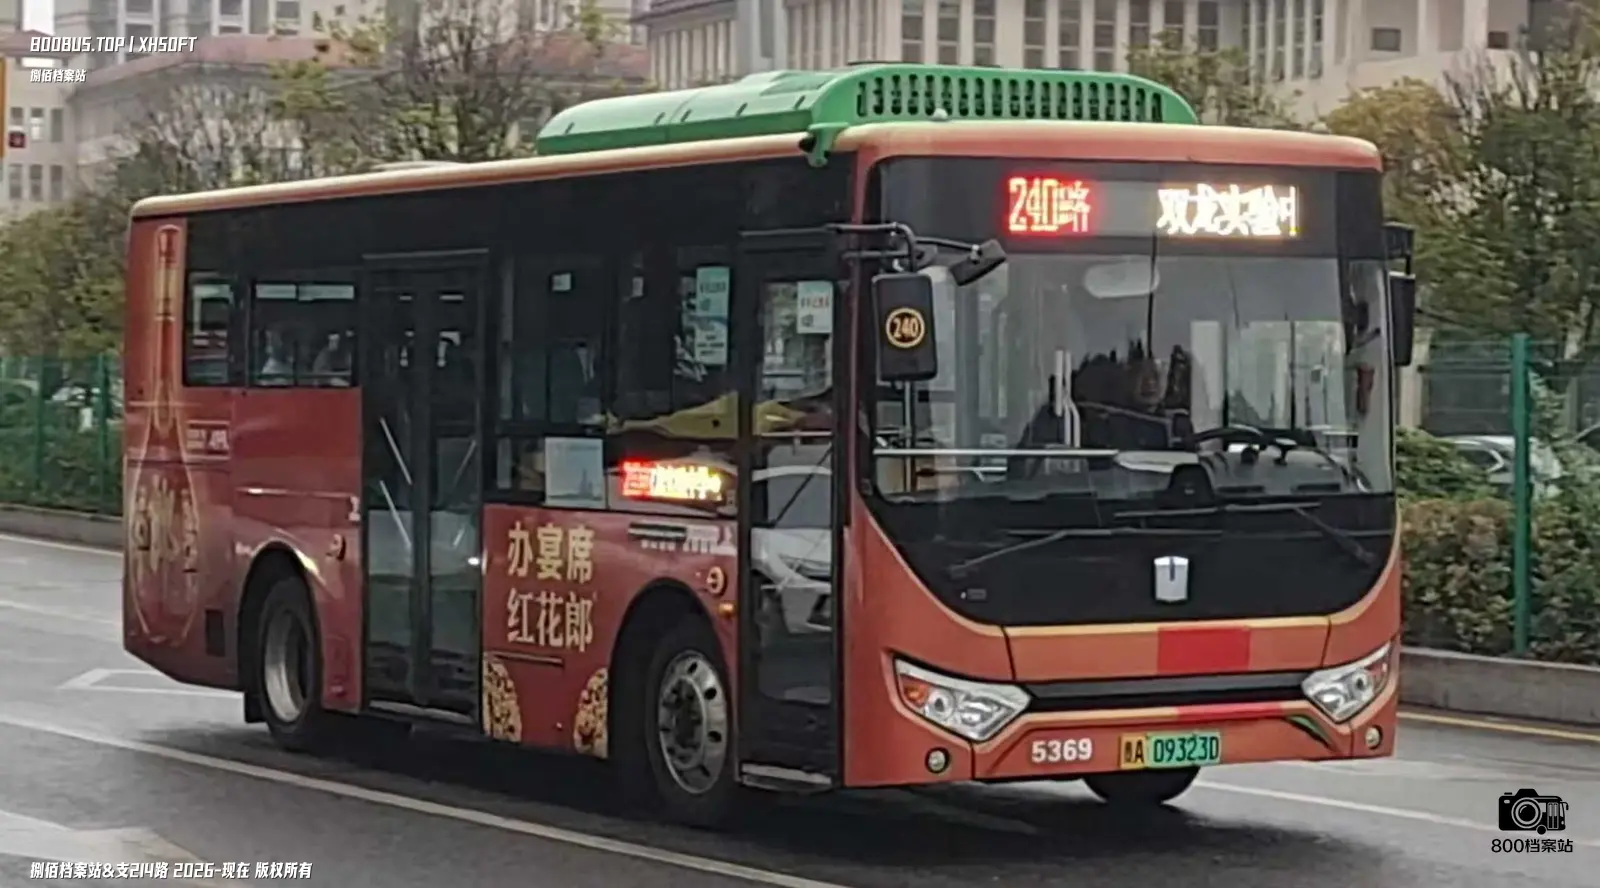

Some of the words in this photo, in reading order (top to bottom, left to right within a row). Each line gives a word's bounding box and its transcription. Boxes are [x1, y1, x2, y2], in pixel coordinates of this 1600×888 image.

[892, 316, 920, 338] 240
[507, 521, 595, 584] 办宴席
[507, 588, 594, 652] 红花郎
[1031, 738, 1093, 763] 5369
